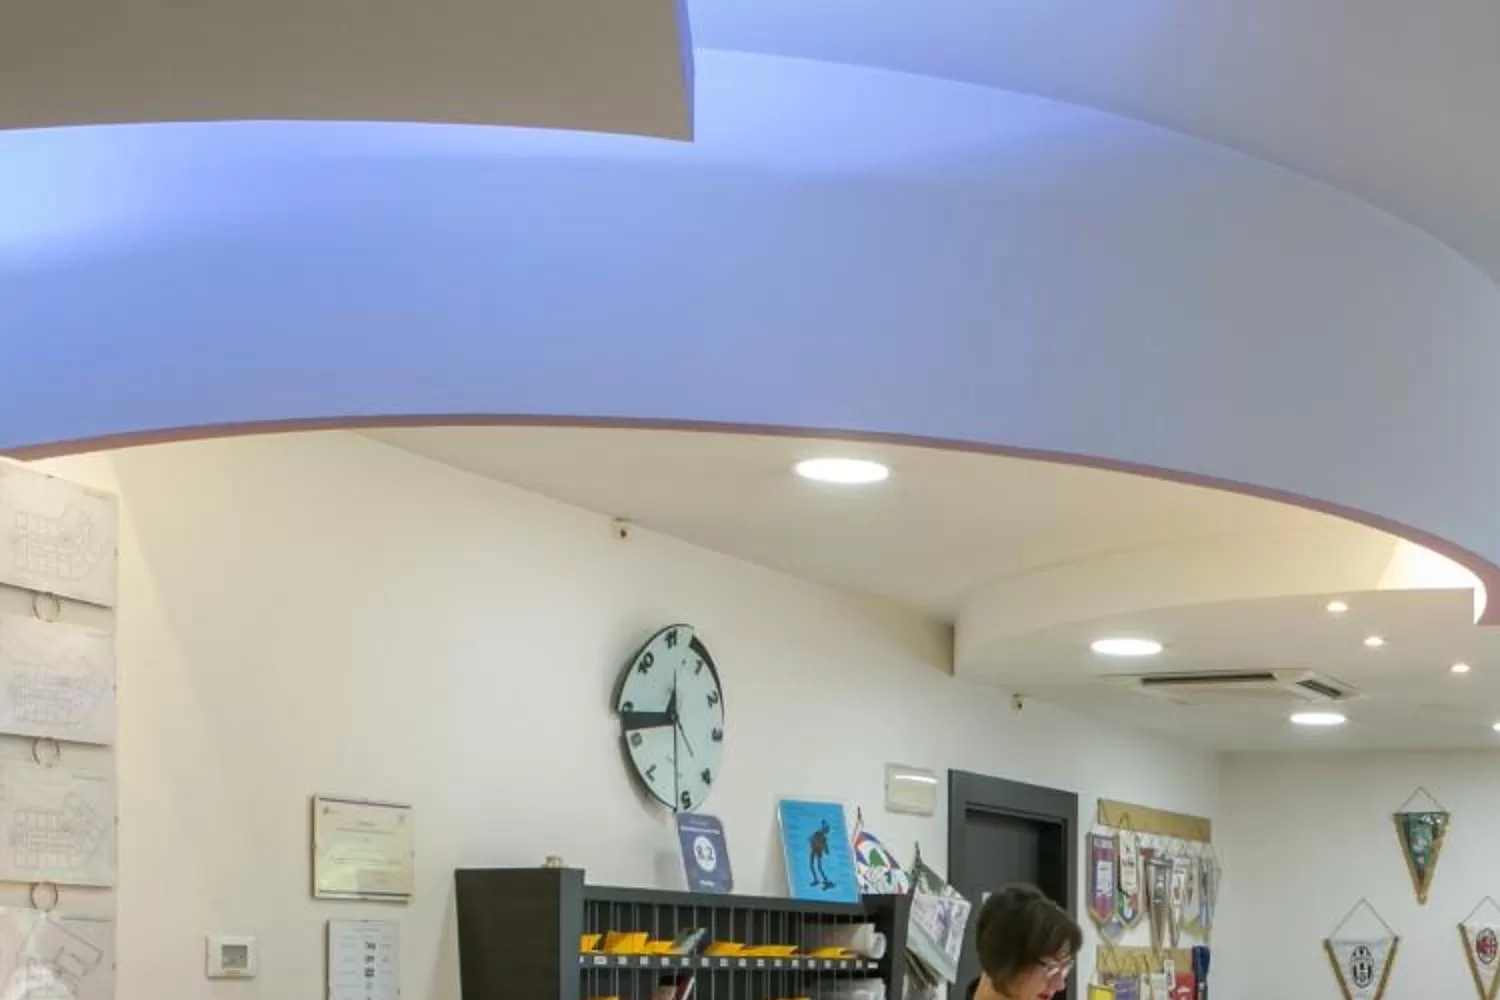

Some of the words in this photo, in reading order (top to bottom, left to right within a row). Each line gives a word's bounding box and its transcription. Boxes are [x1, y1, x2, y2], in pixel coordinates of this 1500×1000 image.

[665, 629, 678, 649] 11
[638, 651, 655, 675] 10
[707, 691, 719, 709] 2
[711, 728, 723, 741] 3
[701, 768, 712, 785] 4
[681, 790, 691, 809] 5
